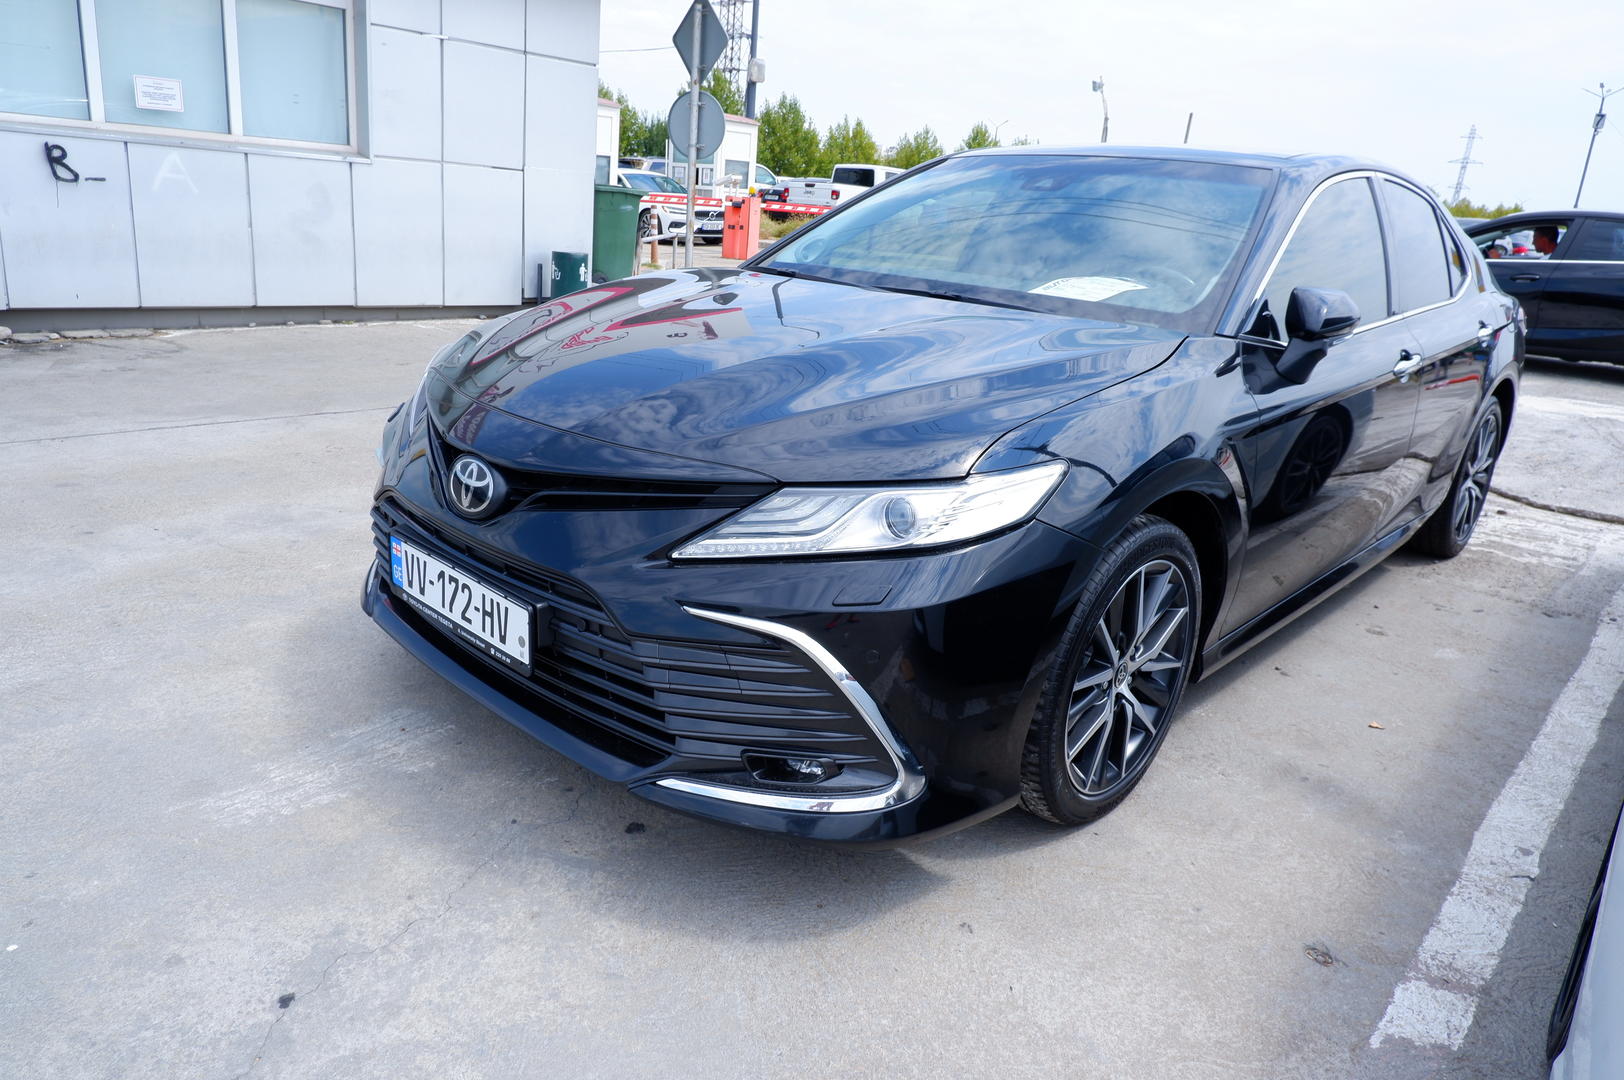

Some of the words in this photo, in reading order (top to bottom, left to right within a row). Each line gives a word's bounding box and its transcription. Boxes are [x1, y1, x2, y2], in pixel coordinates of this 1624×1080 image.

[153, 151, 199, 194] A
[393, 565, 403, 581] GE
[404, 549, 508, 645] VV-172-HV
[423, 605, 438, 620] CENTER
